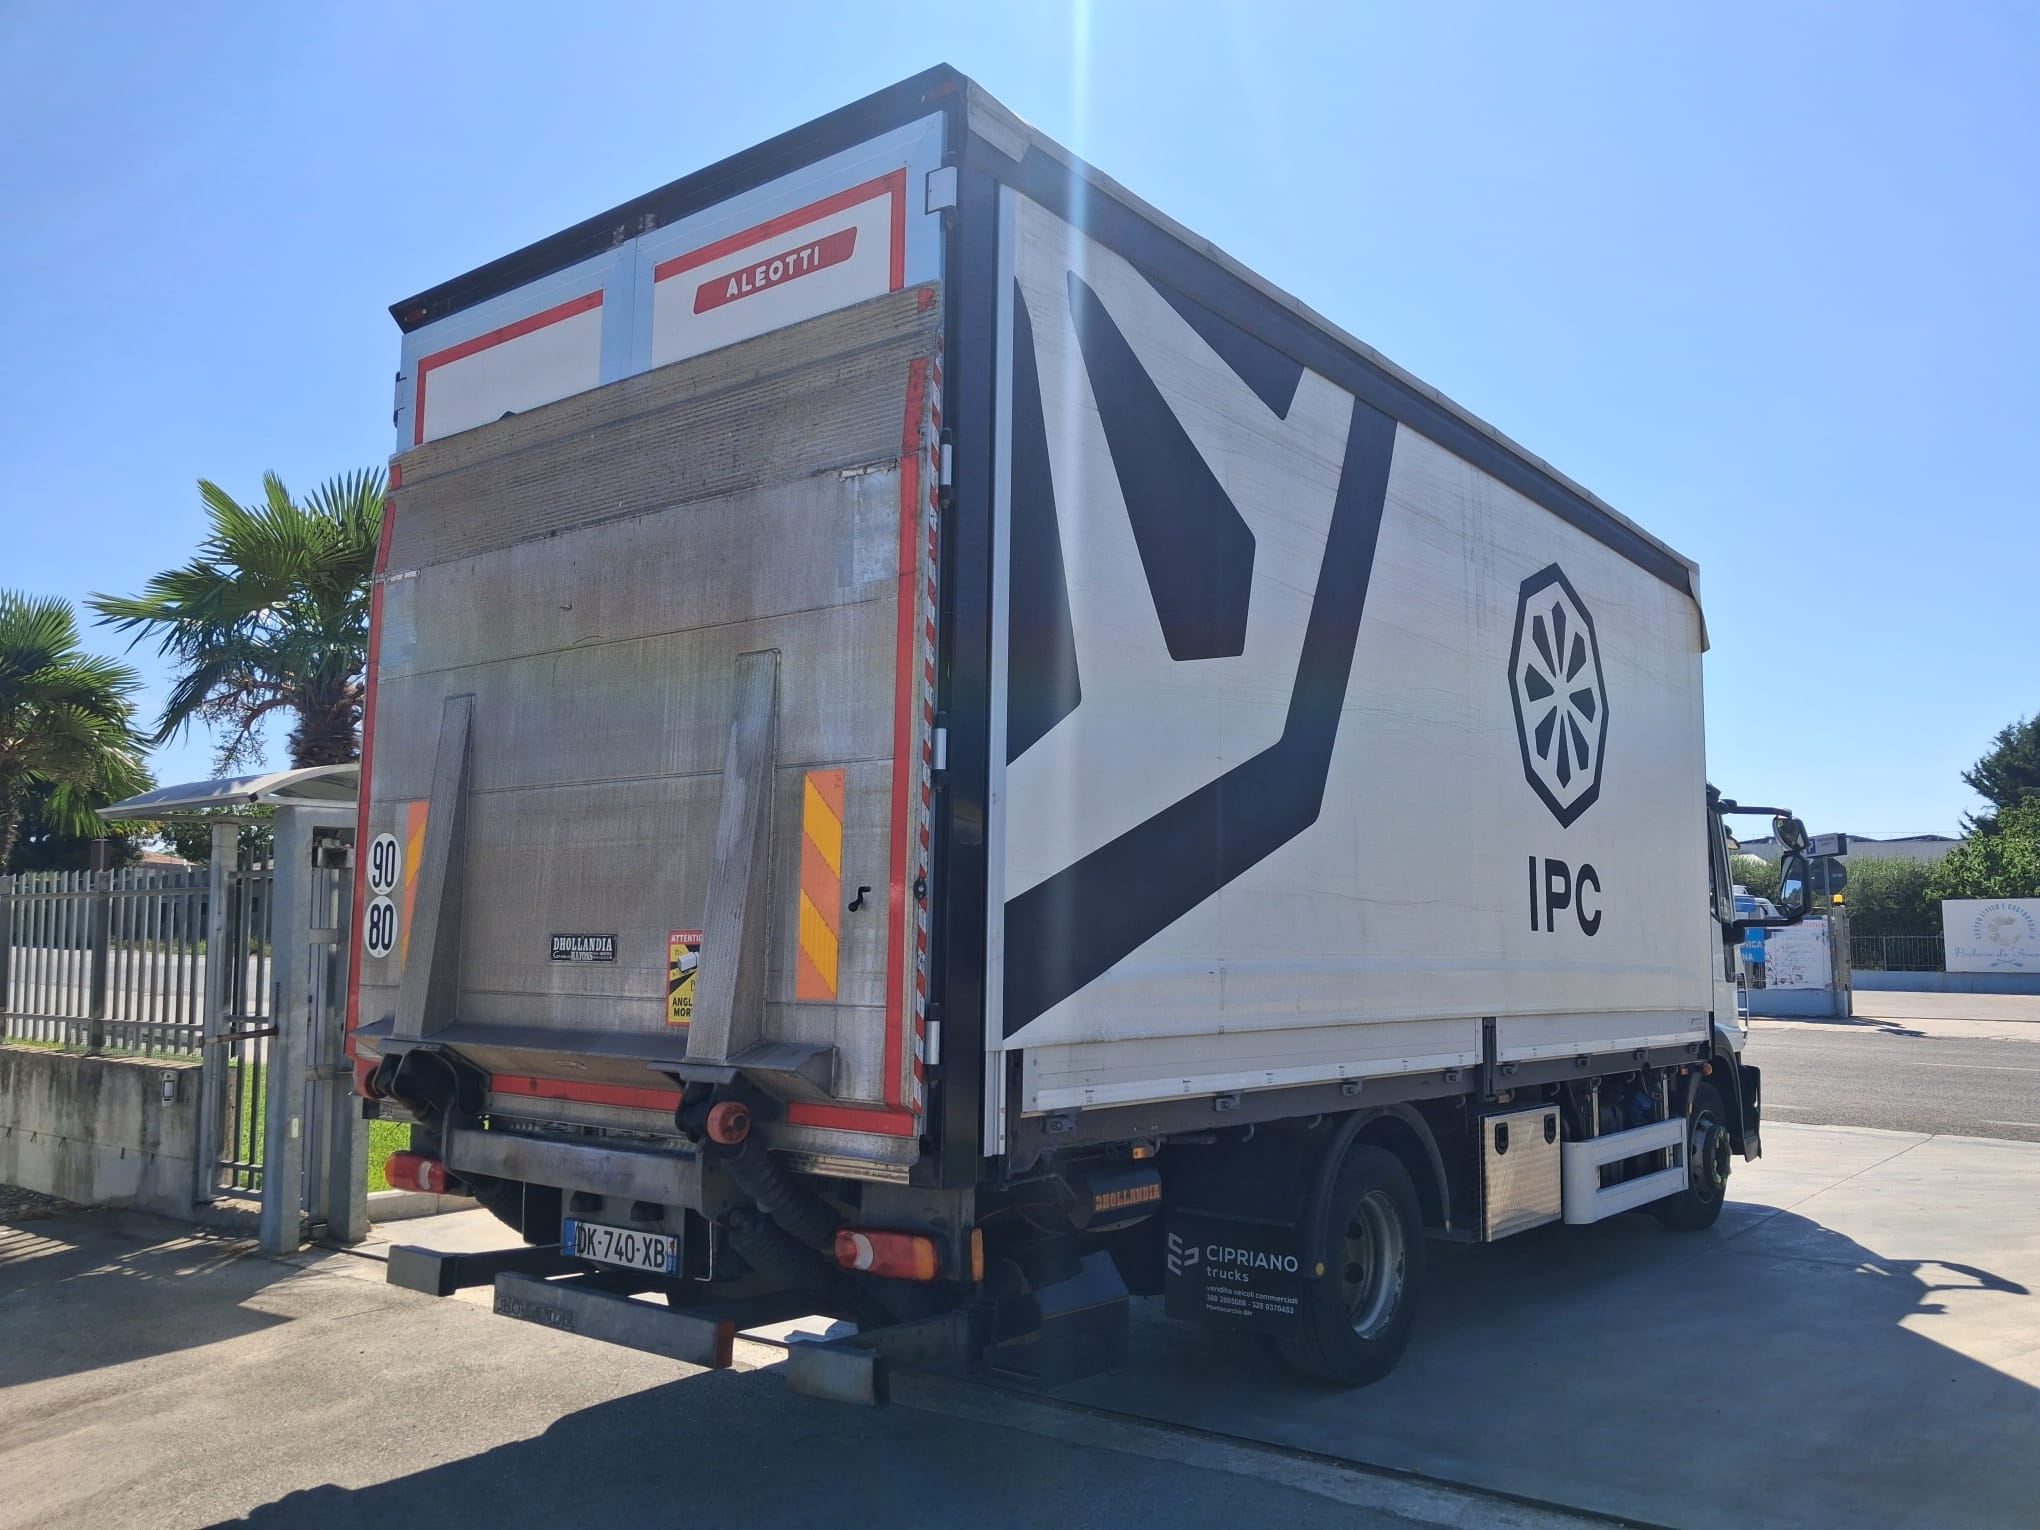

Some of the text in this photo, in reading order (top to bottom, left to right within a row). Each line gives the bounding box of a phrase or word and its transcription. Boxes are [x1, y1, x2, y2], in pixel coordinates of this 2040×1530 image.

[726, 245, 820, 298] ALEOTTI
[372, 840, 396, 888] 90
[1528, 855, 1602, 937] IPC
[368, 903, 394, 951] 80
[552, 937, 613, 951] DHOLLANDIA
[672, 997, 693, 1007] ANGL
[673, 1007, 693, 1017] MOR
[1095, 1184, 1161, 1212] DHOLLANDIA
[576, 1224, 665, 1269] DK-740-XB
[1206, 1245, 1298, 1272] CIPRIANO
[1206, 1265, 1249, 1282] trucks
[1233, 1289, 1255, 1298] veicoli
[1255, 1293, 1298, 1305] commerciali
